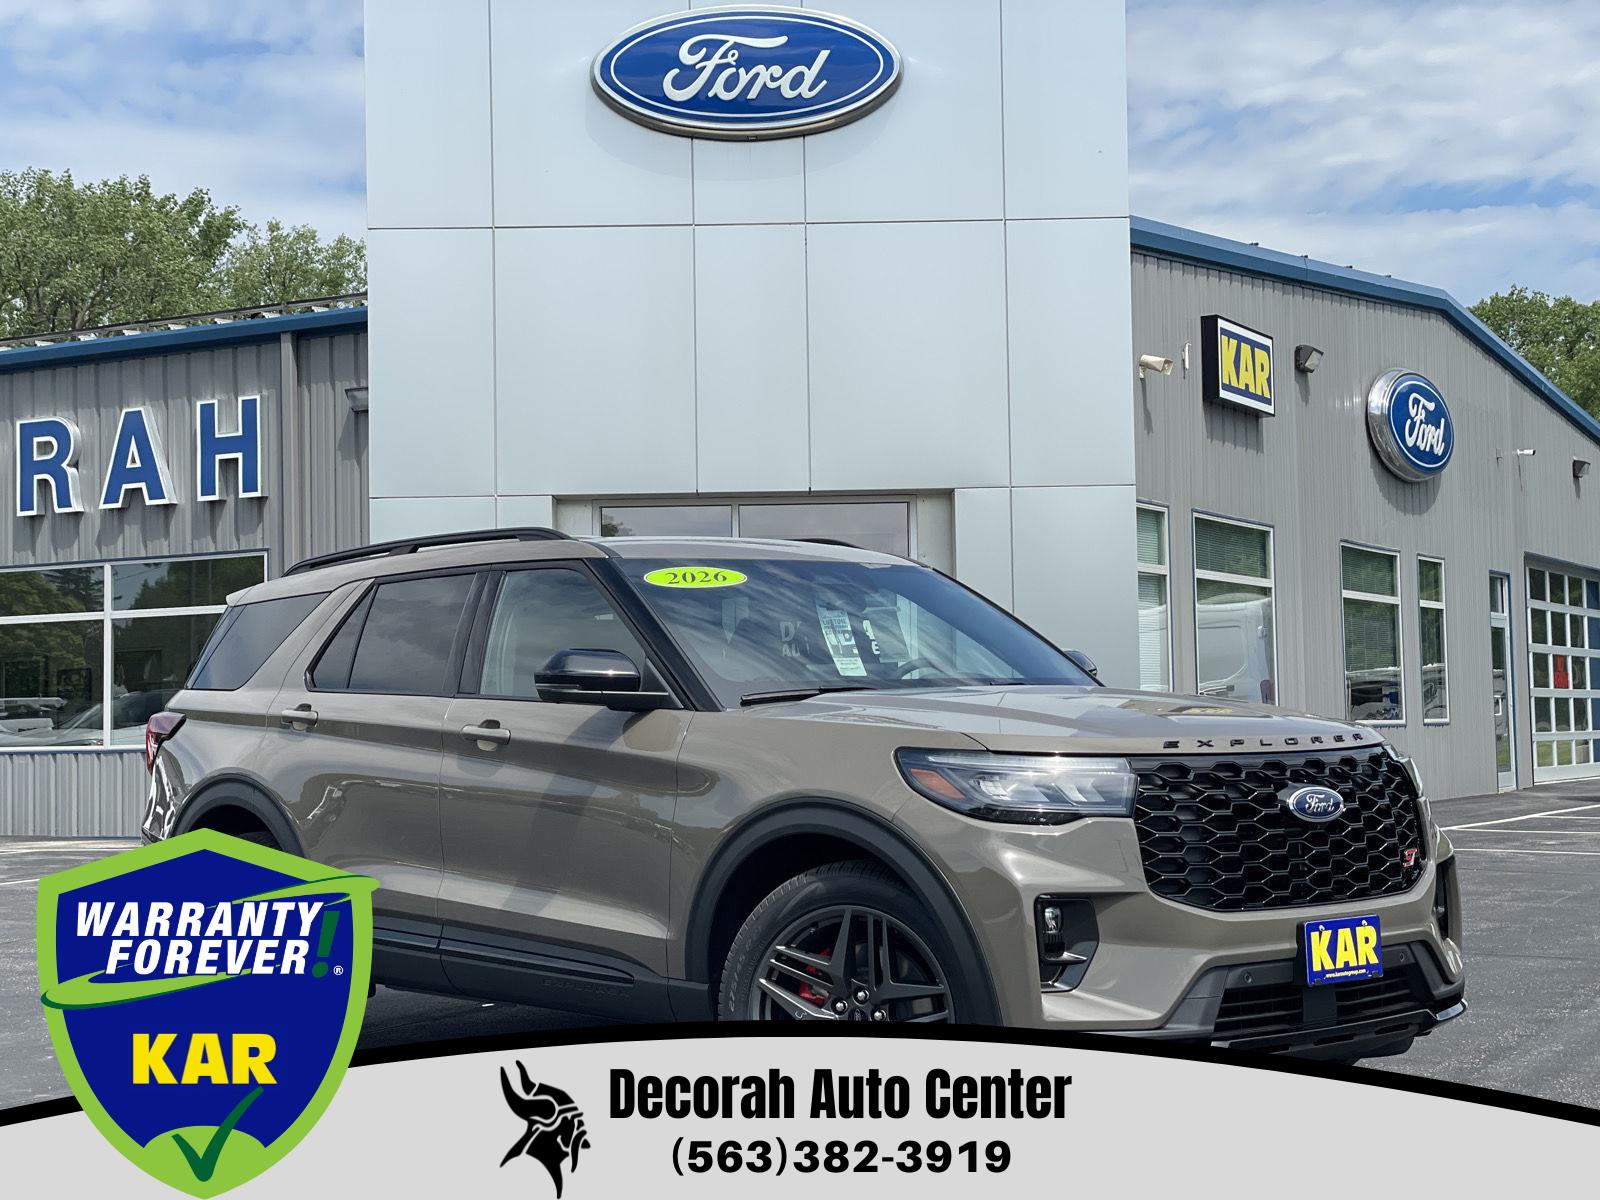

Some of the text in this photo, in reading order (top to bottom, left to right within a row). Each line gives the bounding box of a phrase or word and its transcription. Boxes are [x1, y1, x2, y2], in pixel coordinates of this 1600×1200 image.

[661, 33, 831, 102] Ford
[1221, 335, 1271, 399] KAR
[1405, 392, 1445, 457] Ford
[664, 571, 727, 585] 2026
[1163, 732, 1364, 749] EXPLORER
[1304, 793, 1335, 814] Ford
[1311, 925, 1379, 972] KAR
